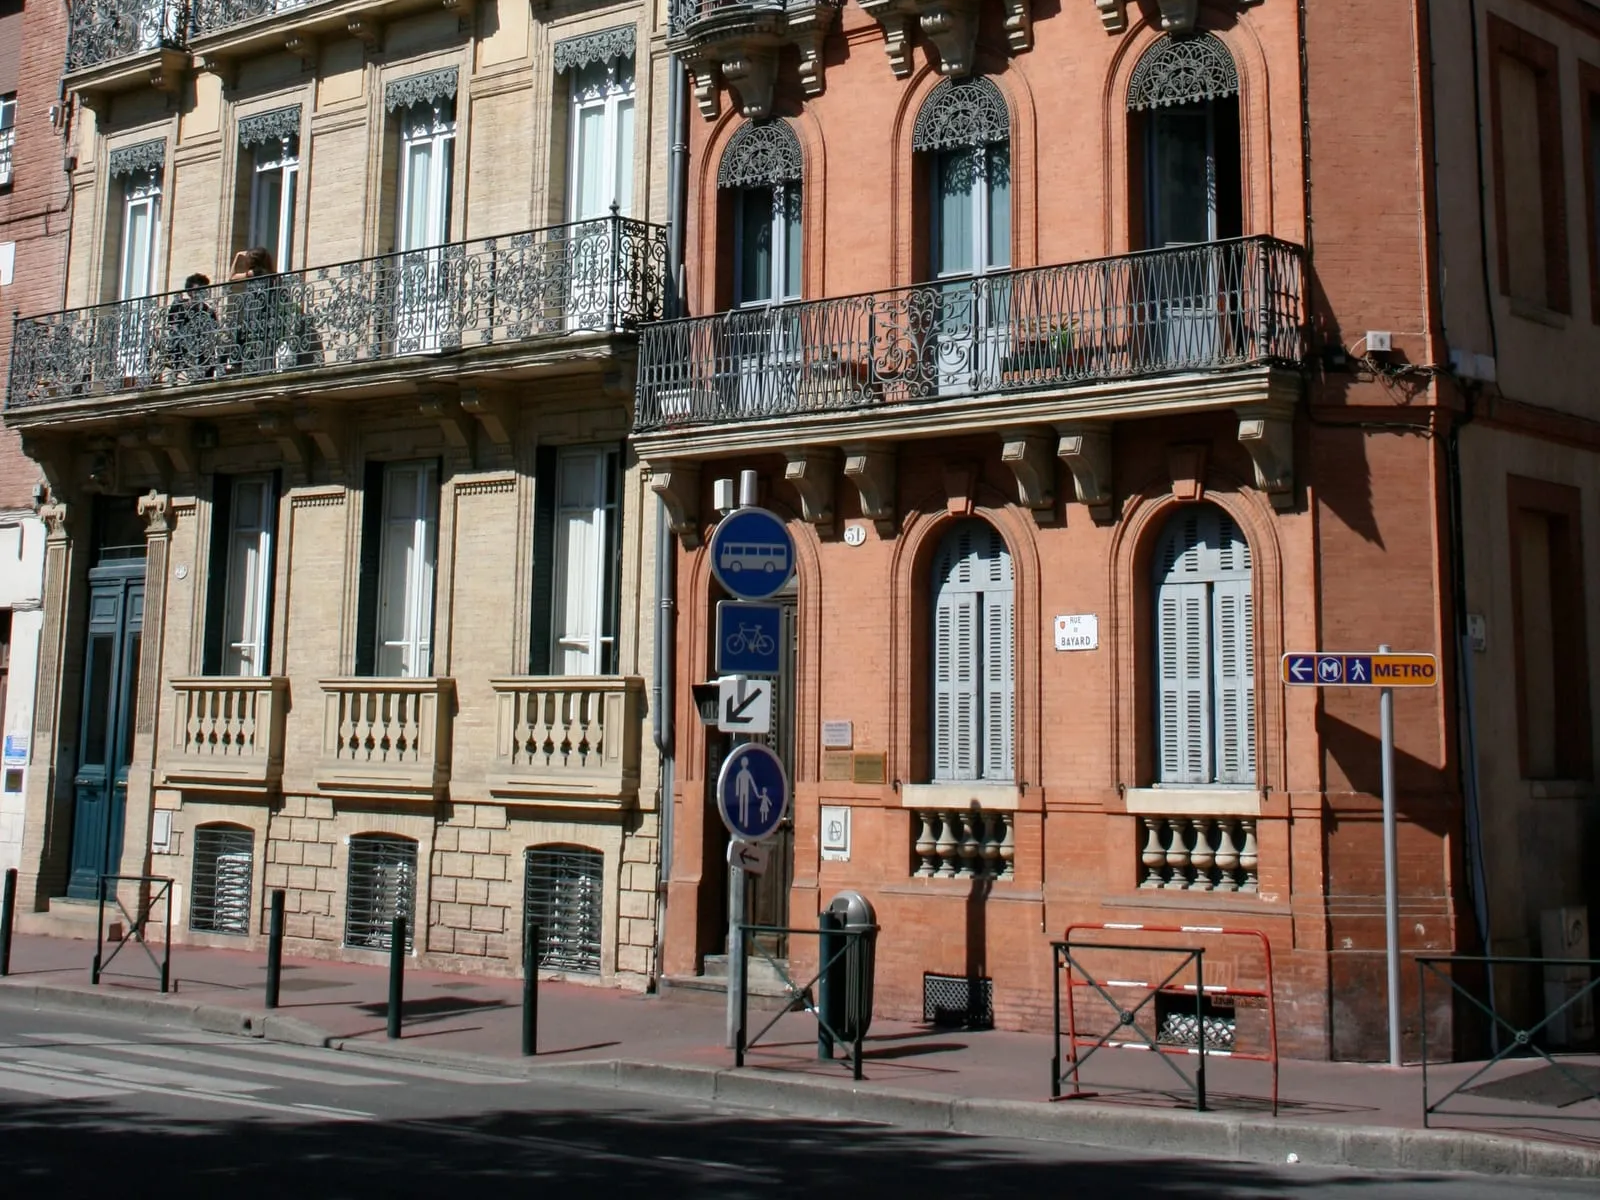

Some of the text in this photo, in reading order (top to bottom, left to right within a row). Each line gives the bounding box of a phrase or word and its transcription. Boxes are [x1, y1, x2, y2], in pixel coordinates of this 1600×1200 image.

[847, 527, 860, 542] 51
[1069, 616, 1081, 624] RUE
[1061, 636, 1091, 646] BAYARD
[1374, 663, 1435, 678] METRO
